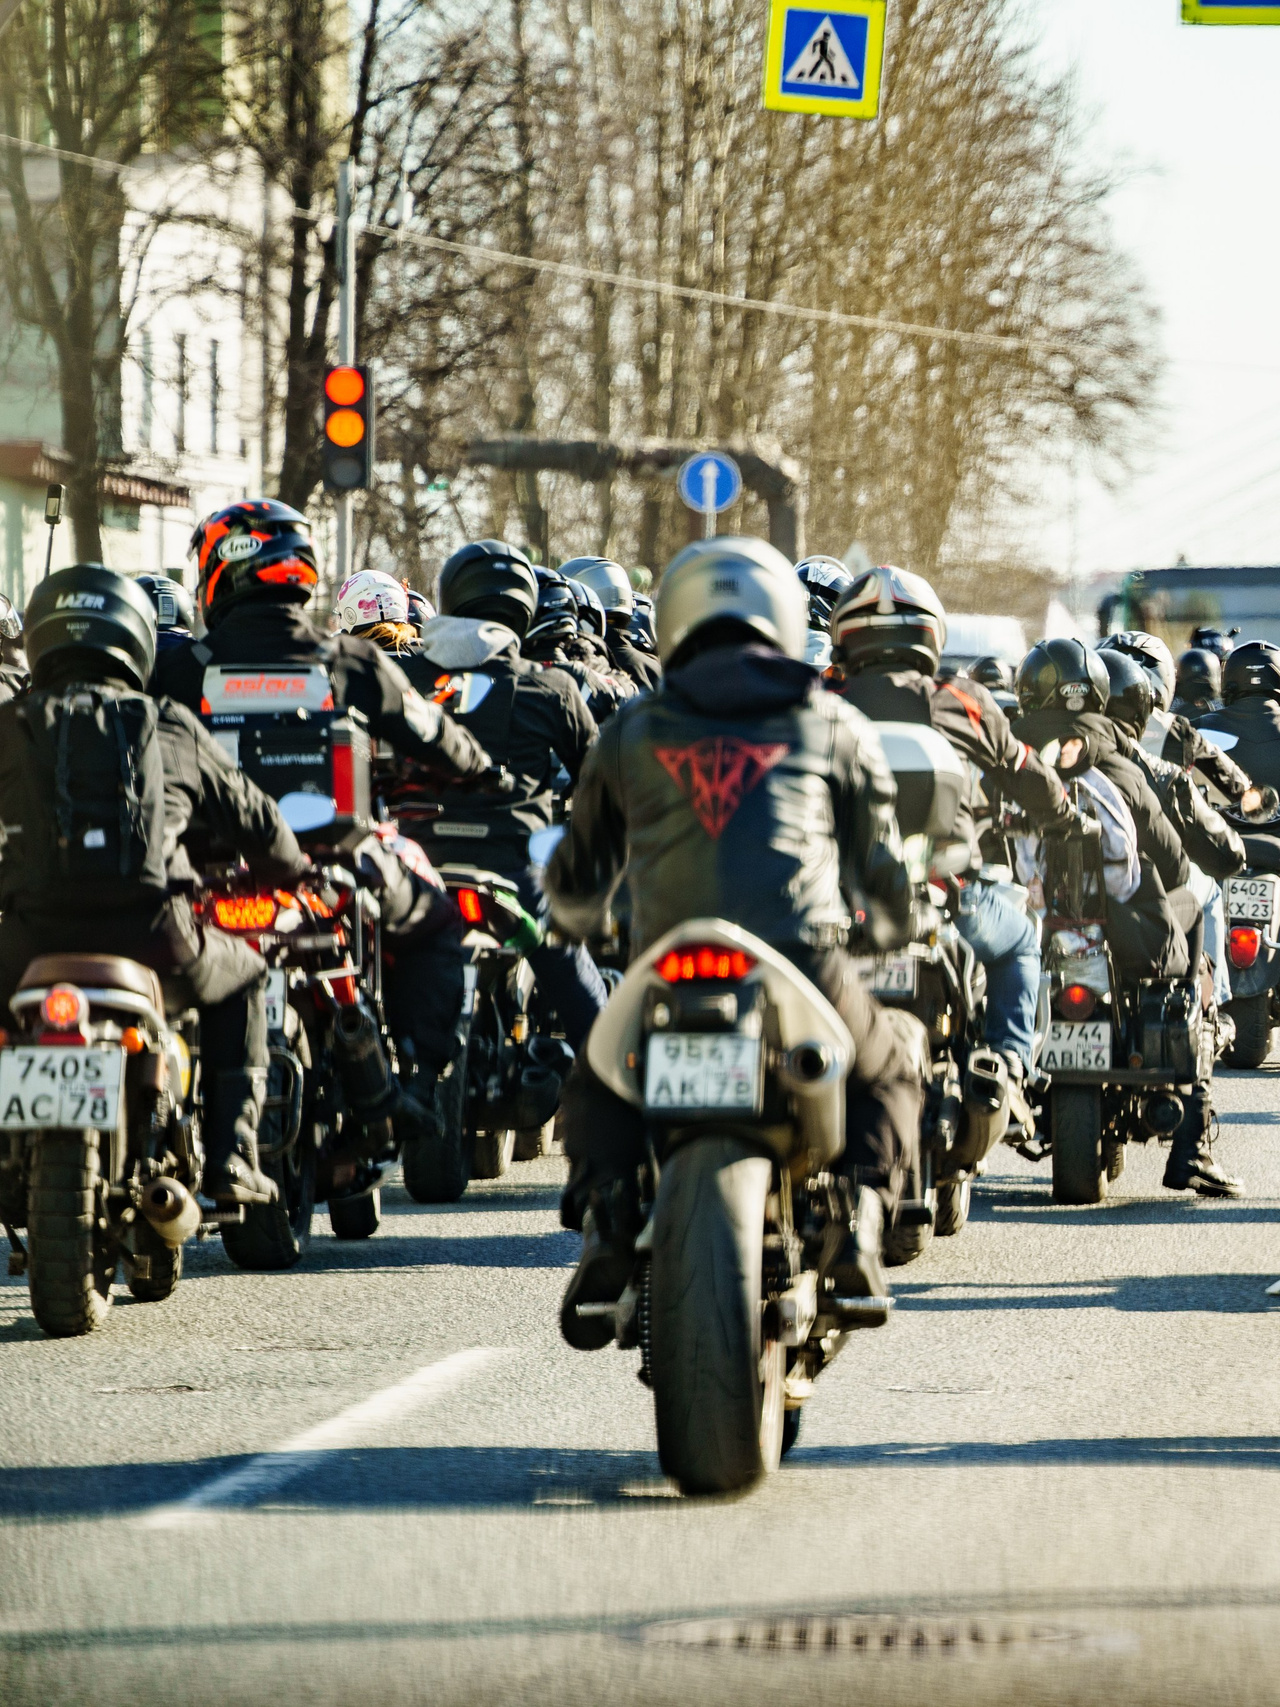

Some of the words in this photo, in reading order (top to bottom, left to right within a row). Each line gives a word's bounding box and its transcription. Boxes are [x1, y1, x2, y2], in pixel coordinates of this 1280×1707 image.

[55, 592, 105, 610] LAZER
[1230, 881, 1267, 897] 6402
[1251, 903, 1269, 917] 23
[1051, 1023, 1101, 1041] 5744
[1081, 1048, 1105, 1067] 56
[17, 1054, 102, 1082] 7405
[69, 1092, 108, 1122] 78
